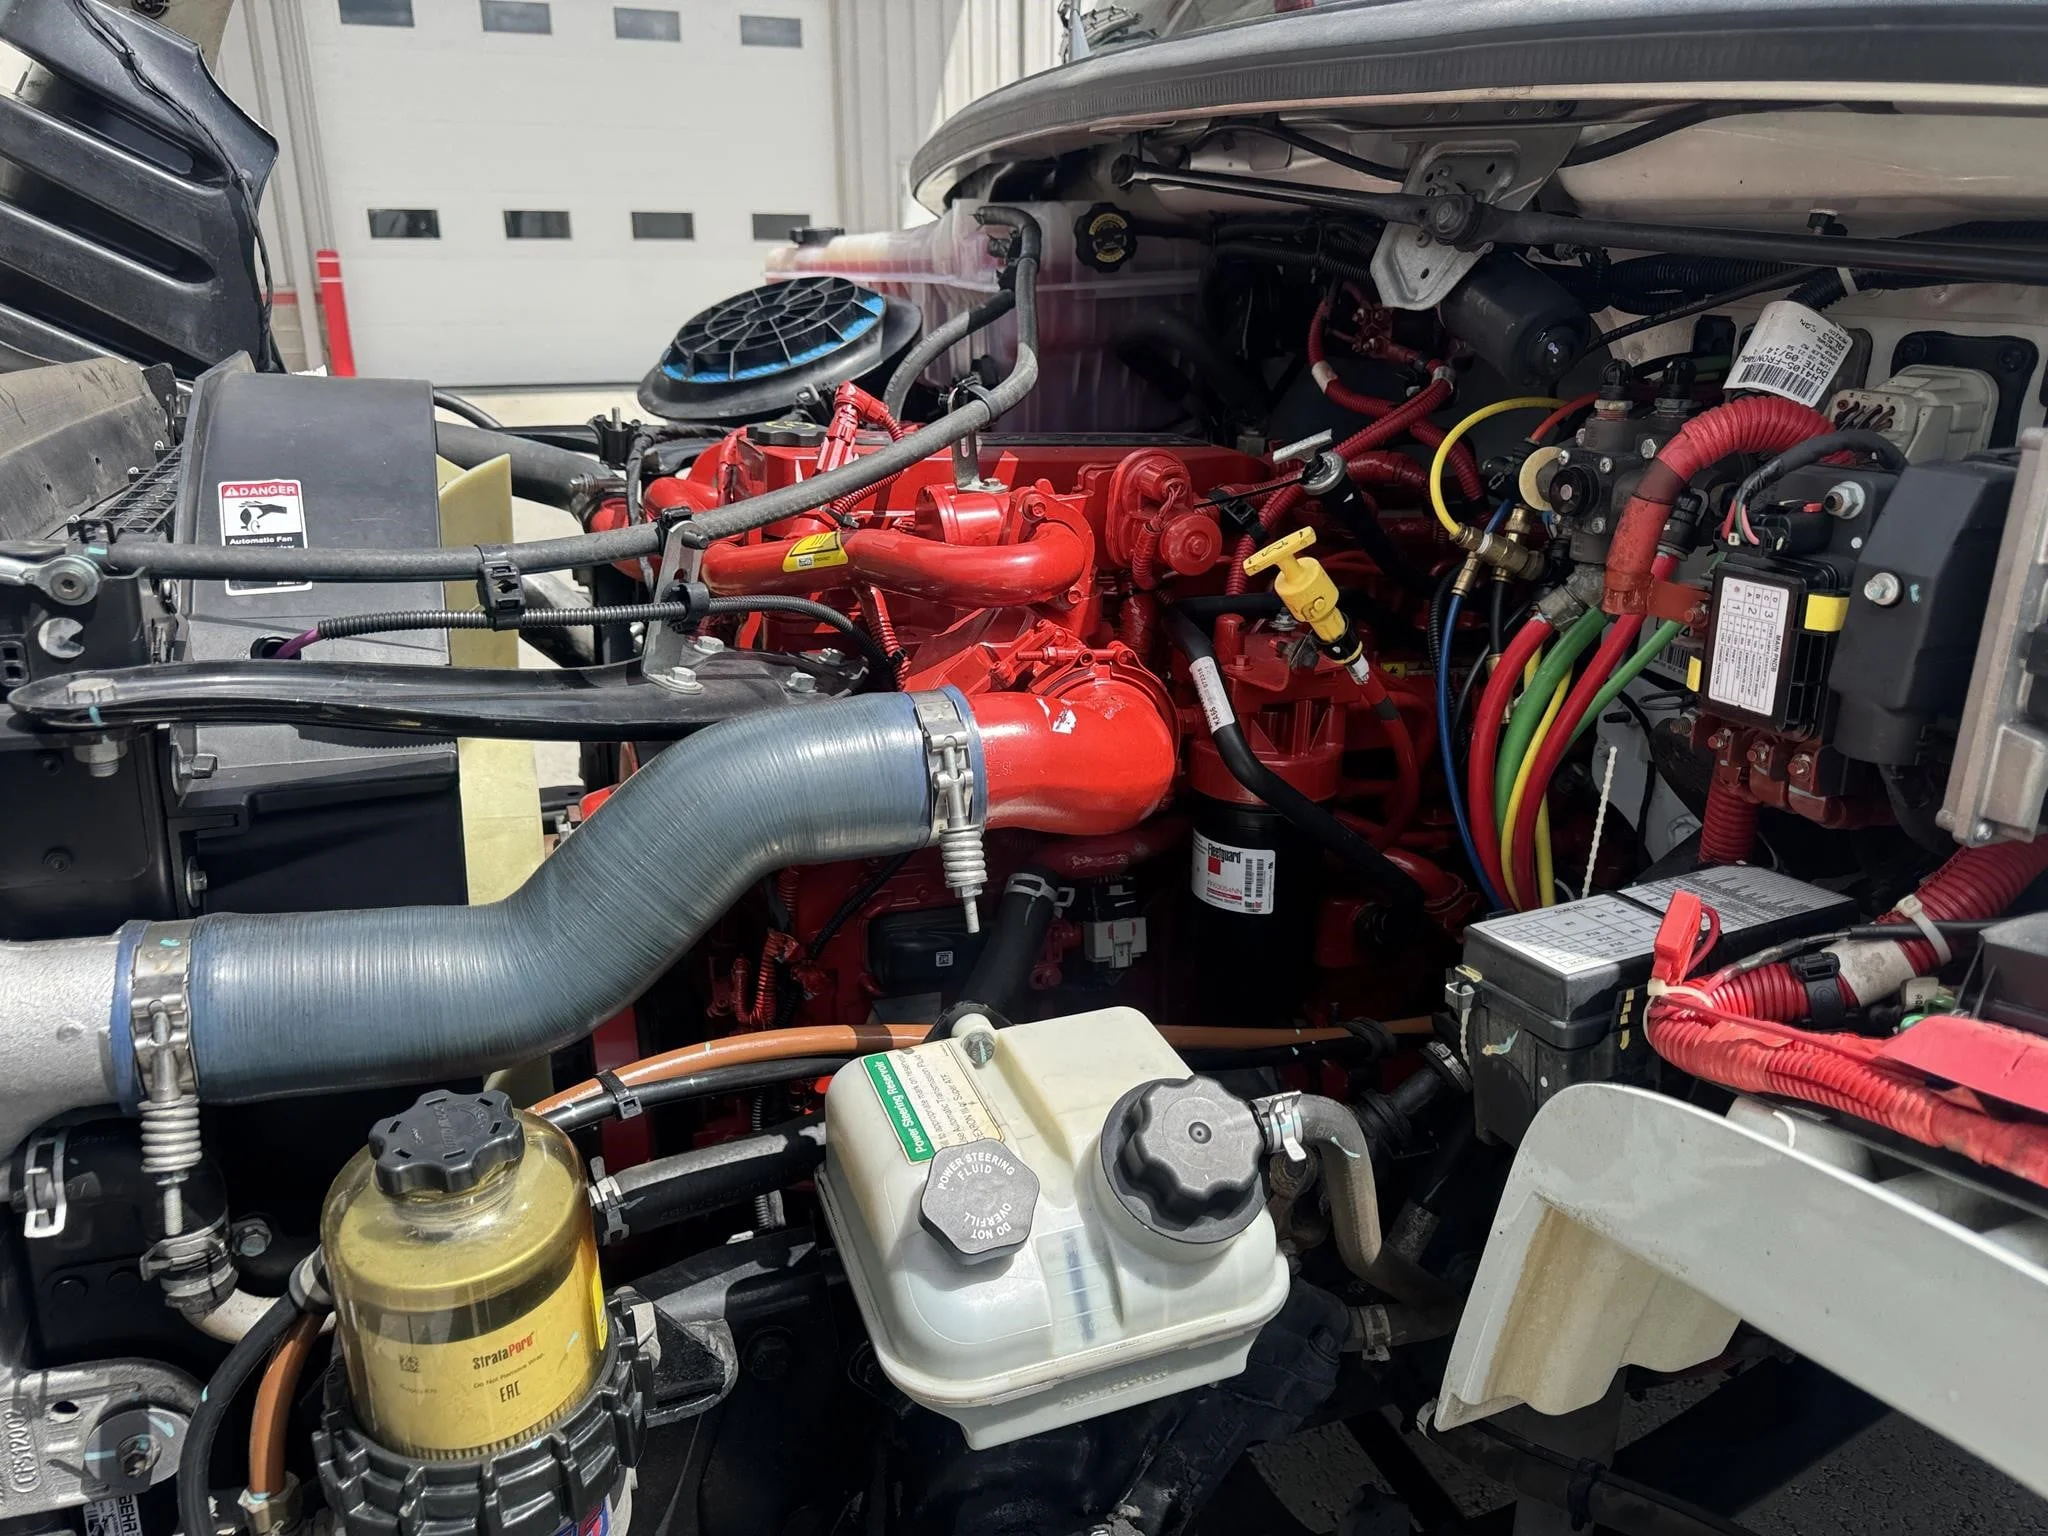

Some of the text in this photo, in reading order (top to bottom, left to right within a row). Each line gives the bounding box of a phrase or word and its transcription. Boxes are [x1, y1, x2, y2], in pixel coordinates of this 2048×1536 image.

[239, 486, 296, 496] DANGER
[229, 537, 275, 545] Automatic
[1207, 843, 1241, 864] Fleetguard
[874, 1061, 928, 1154] Power Steering Reservoir
[937, 1152, 1016, 1190] POWER STEERING
[957, 1163, 992, 1181] FLUID
[963, 1202, 1012, 1227] OVERFILL
[970, 1221, 1012, 1240] DO NOT
[472, 1334, 533, 1370] StrataPore
